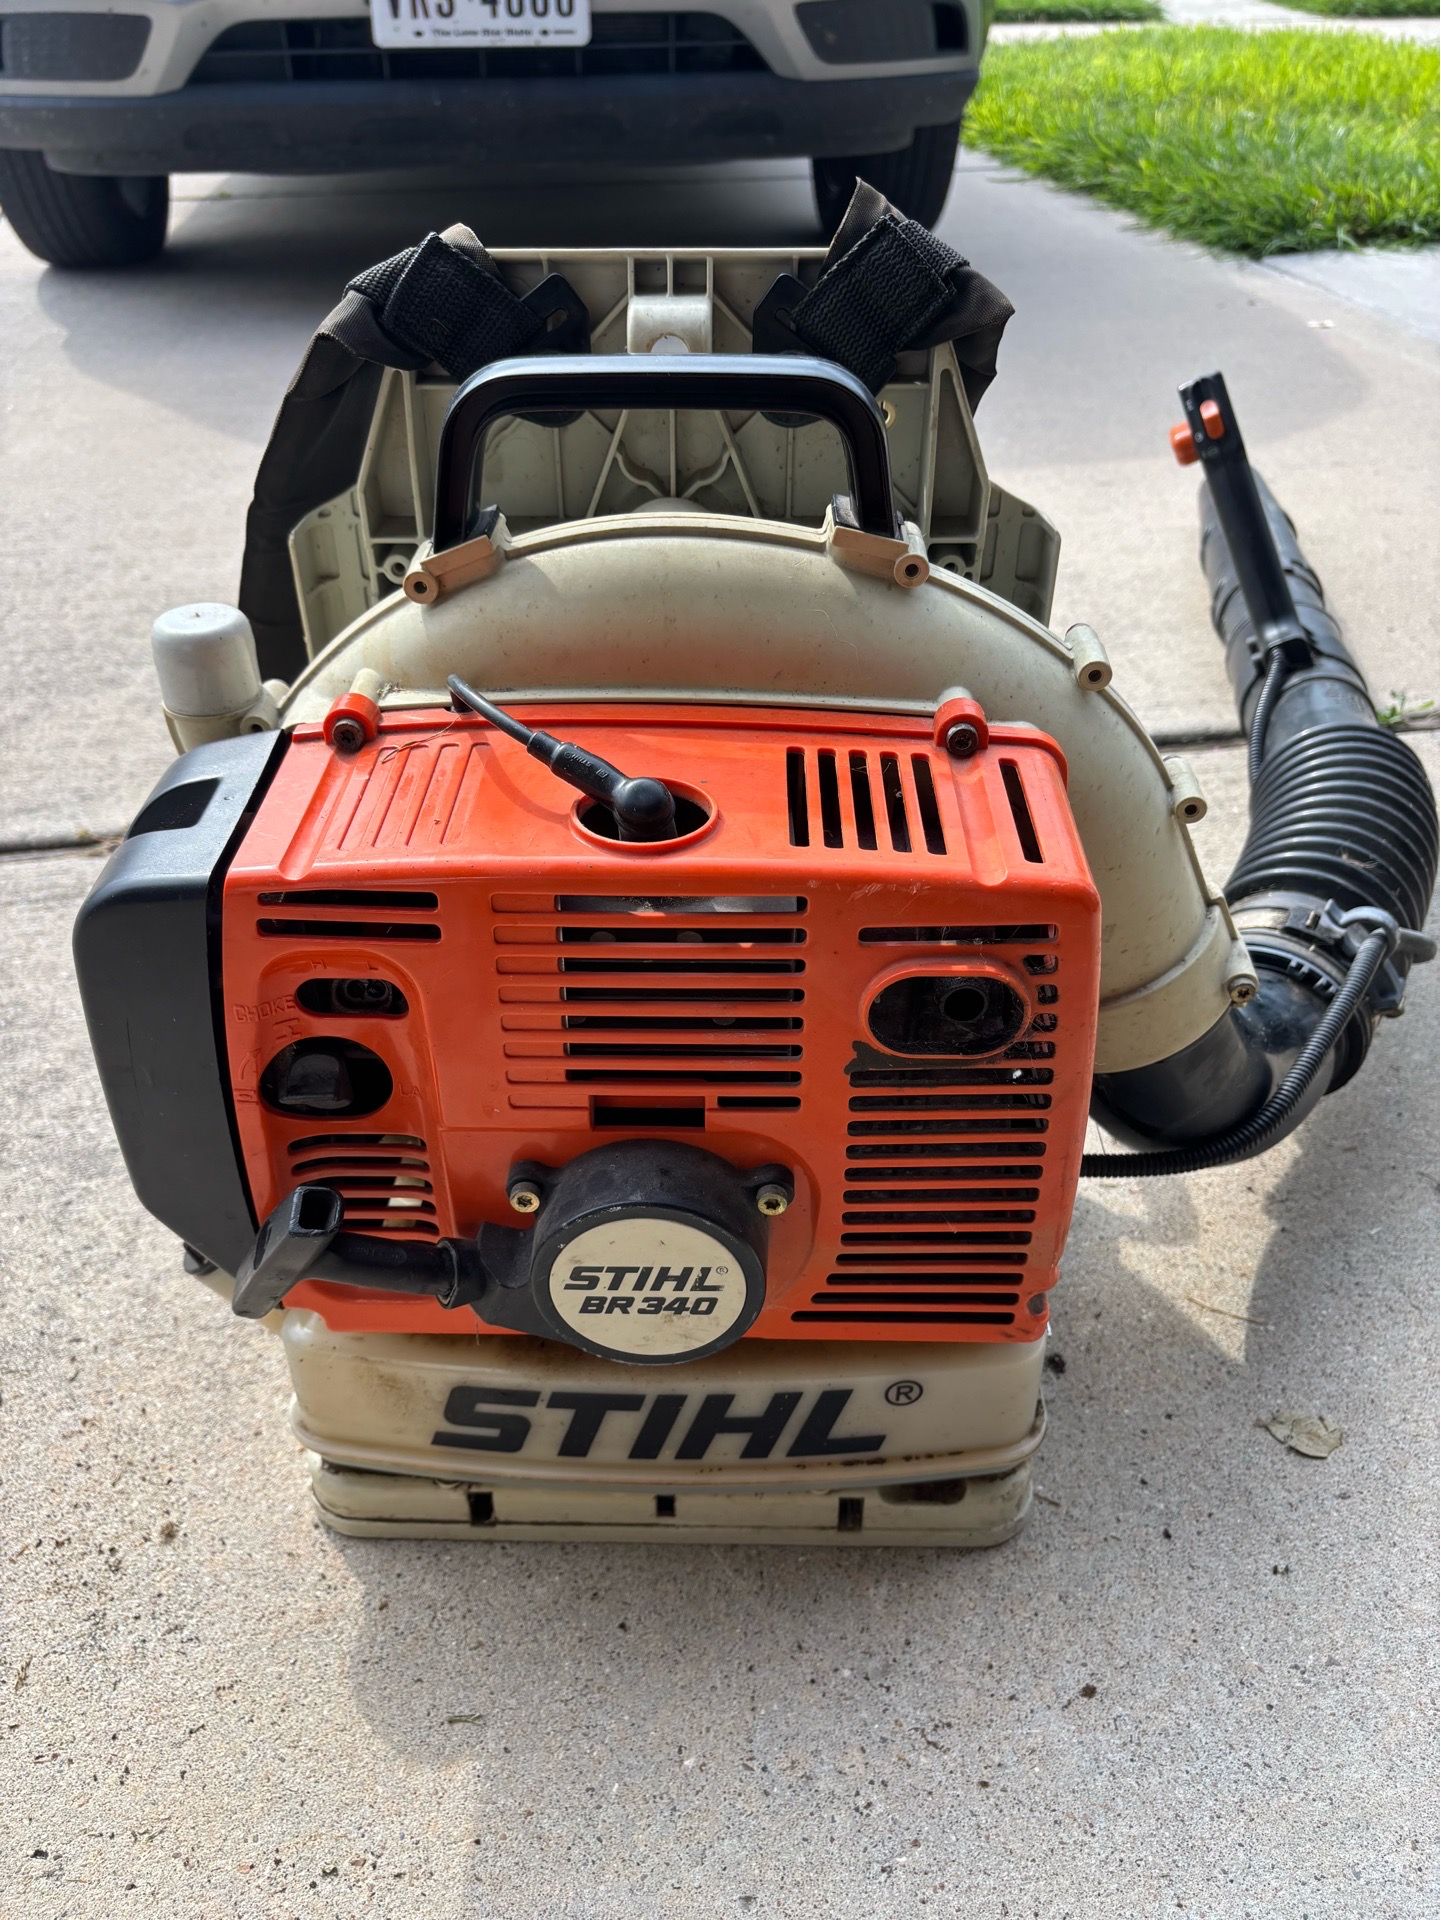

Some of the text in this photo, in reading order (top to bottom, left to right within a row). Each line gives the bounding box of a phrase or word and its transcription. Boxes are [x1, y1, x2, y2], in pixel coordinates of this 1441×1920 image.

[232, 994, 297, 1023] CHOKE
[578, 1296, 719, 1316] BR 340
